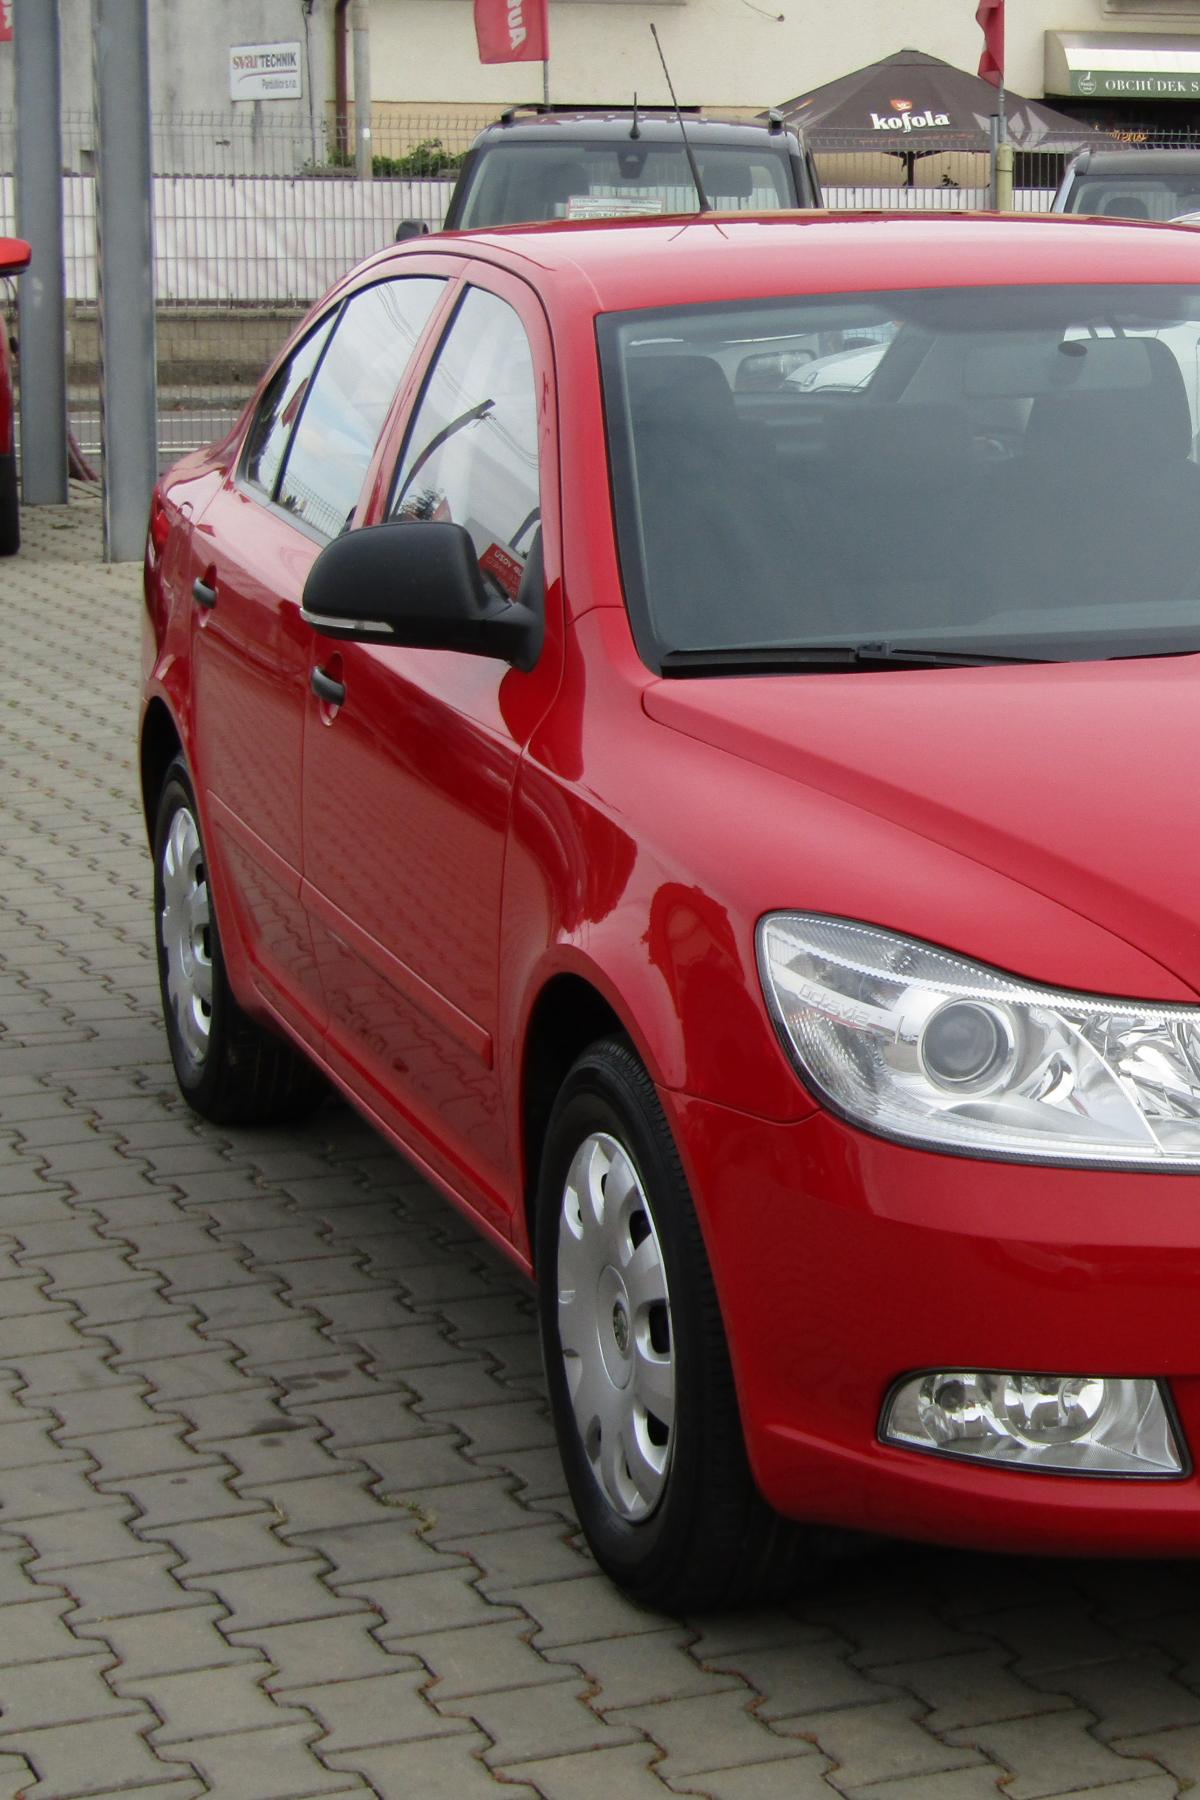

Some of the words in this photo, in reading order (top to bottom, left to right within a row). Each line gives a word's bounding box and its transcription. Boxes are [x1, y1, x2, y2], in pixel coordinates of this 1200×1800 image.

[1105, 77, 1187, 93] OBCHŮDEK
[1191, 81, 1200, 92] S
[870, 111, 951, 133] kofola
